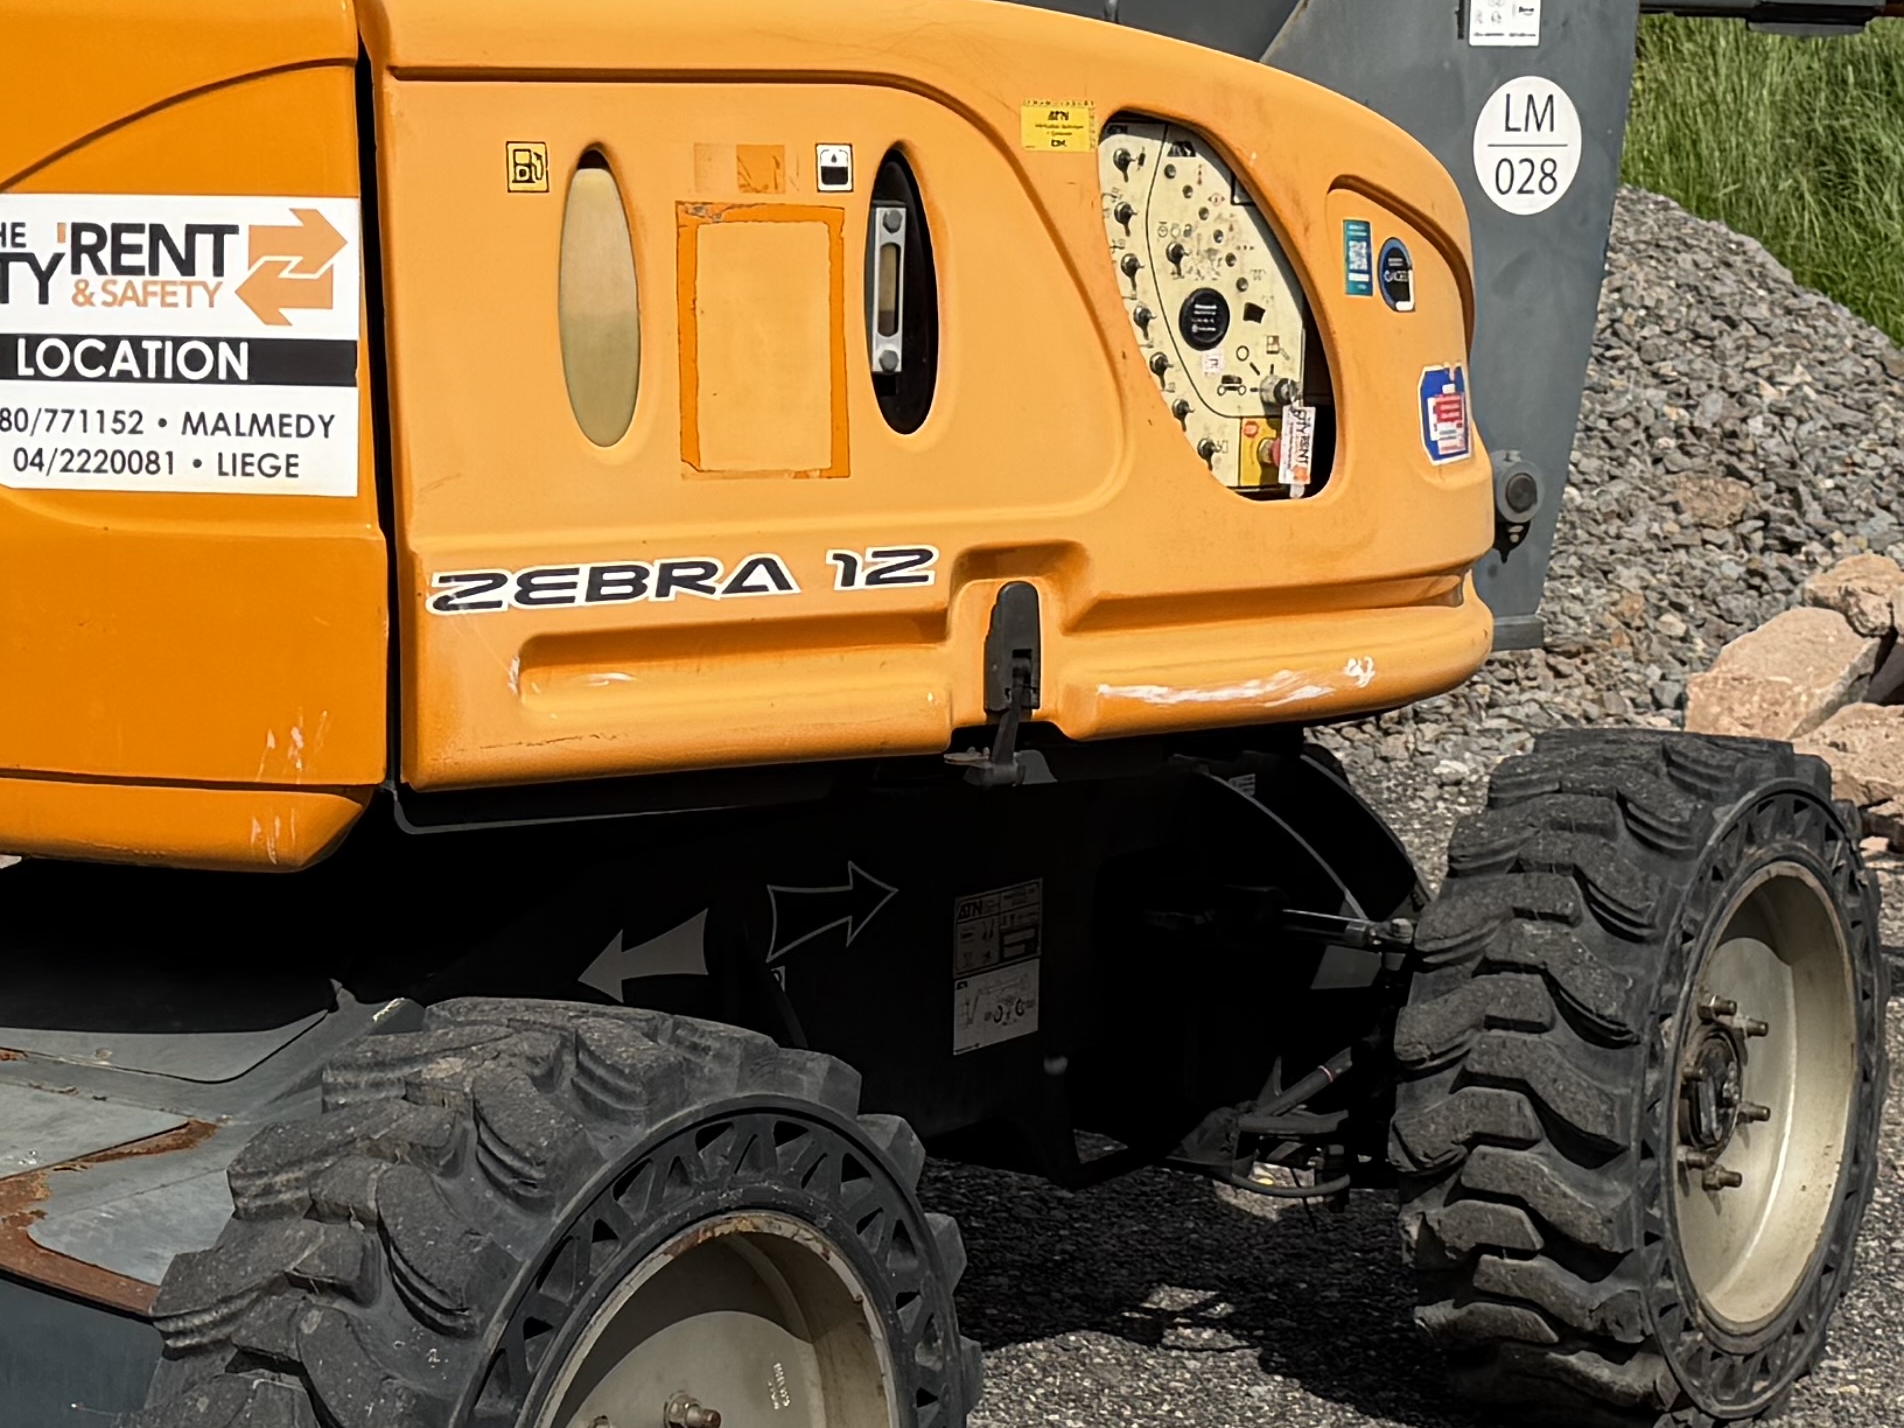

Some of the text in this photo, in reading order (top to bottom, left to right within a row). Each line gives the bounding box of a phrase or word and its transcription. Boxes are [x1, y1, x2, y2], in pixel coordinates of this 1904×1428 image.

[1505, 94, 1555, 133] LM
[1495, 158, 1558, 195] 028
[70, 279, 224, 309] & SAFETY
[17, 338, 249, 381] LOCATION
[181, 412, 336, 440] MALMEDY
[13, 448, 300, 479] 04/2220081 LIEGE
[427, 545, 939, 614] ZEBRA 12
